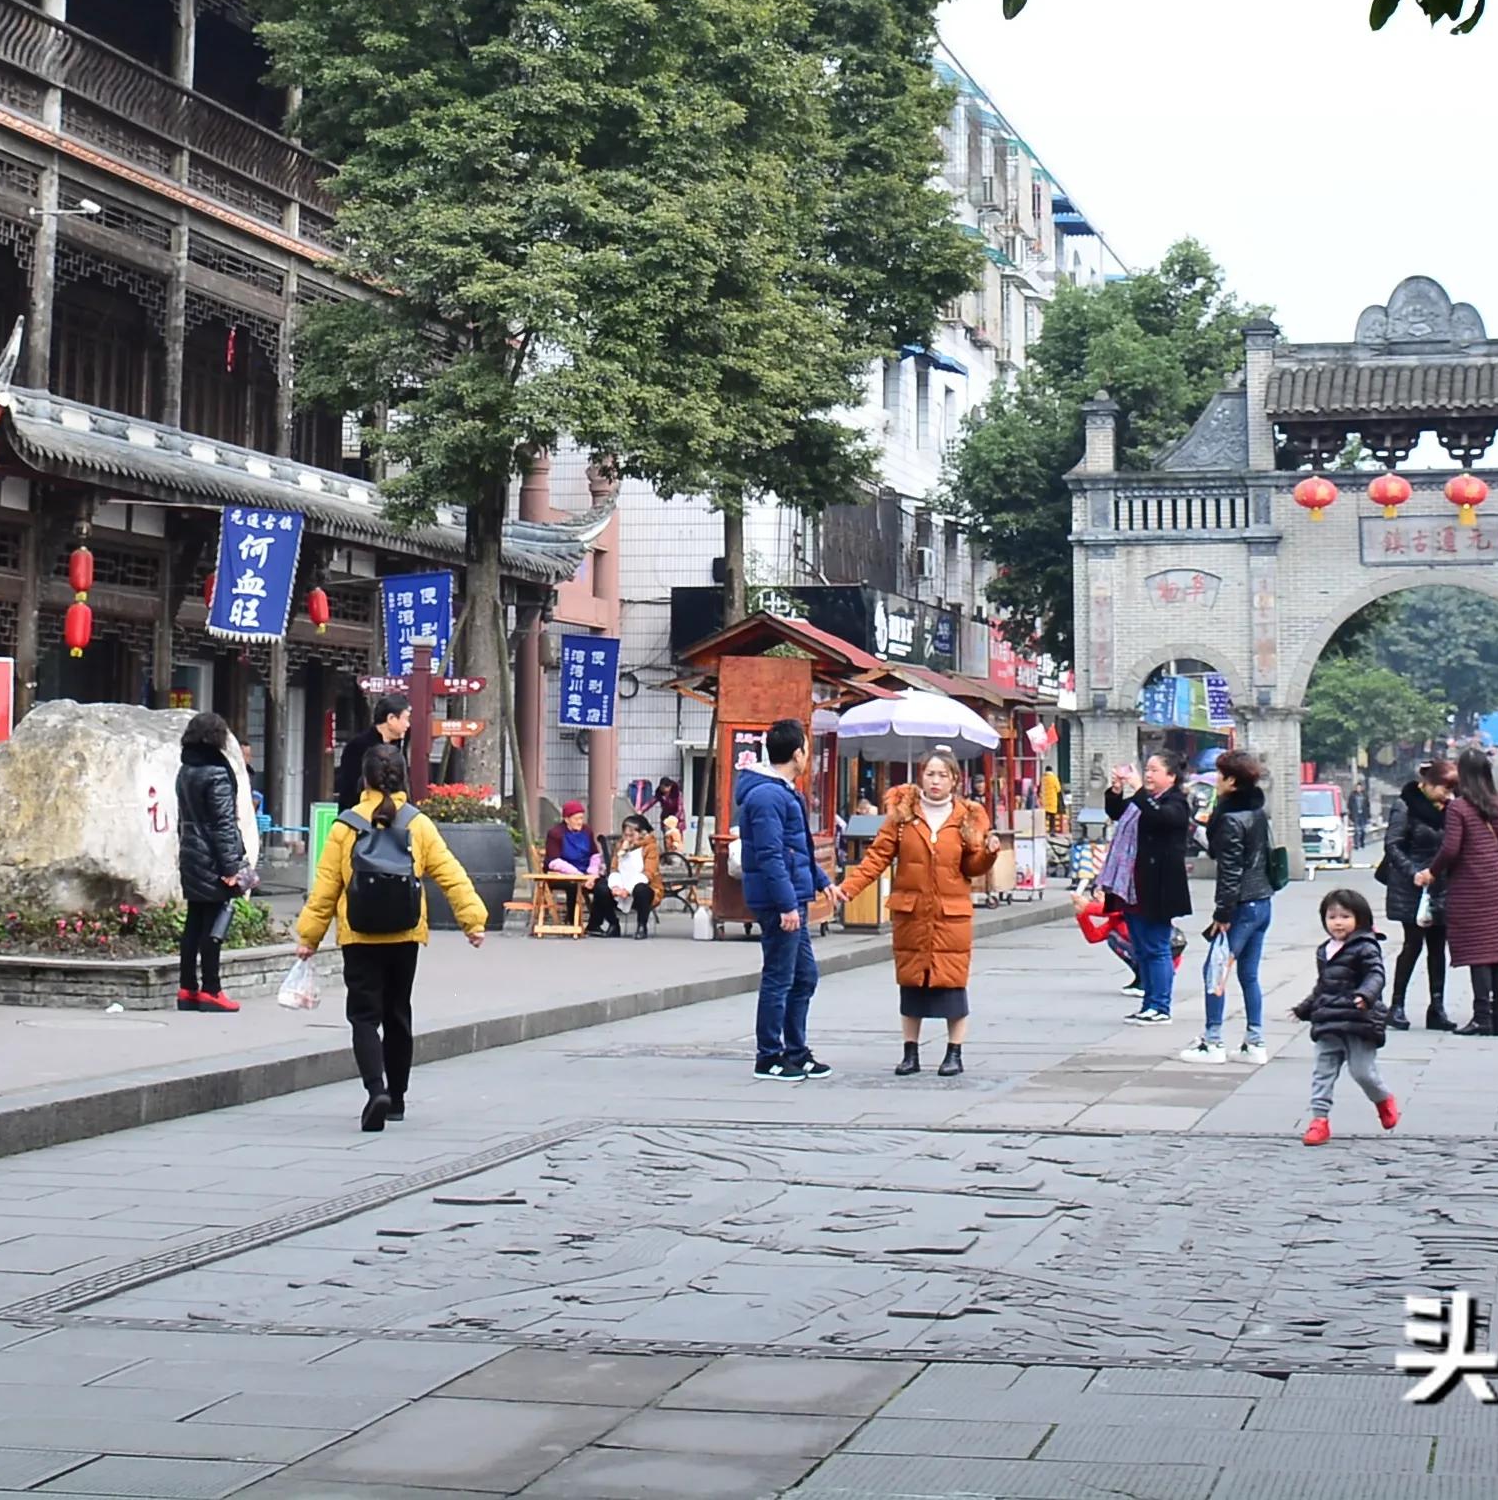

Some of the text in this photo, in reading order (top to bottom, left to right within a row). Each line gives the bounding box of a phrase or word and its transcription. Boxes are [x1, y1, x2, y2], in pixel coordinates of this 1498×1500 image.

[230, 509, 293, 531] 元通古镇
[228, 533, 276, 627] 何血旺
